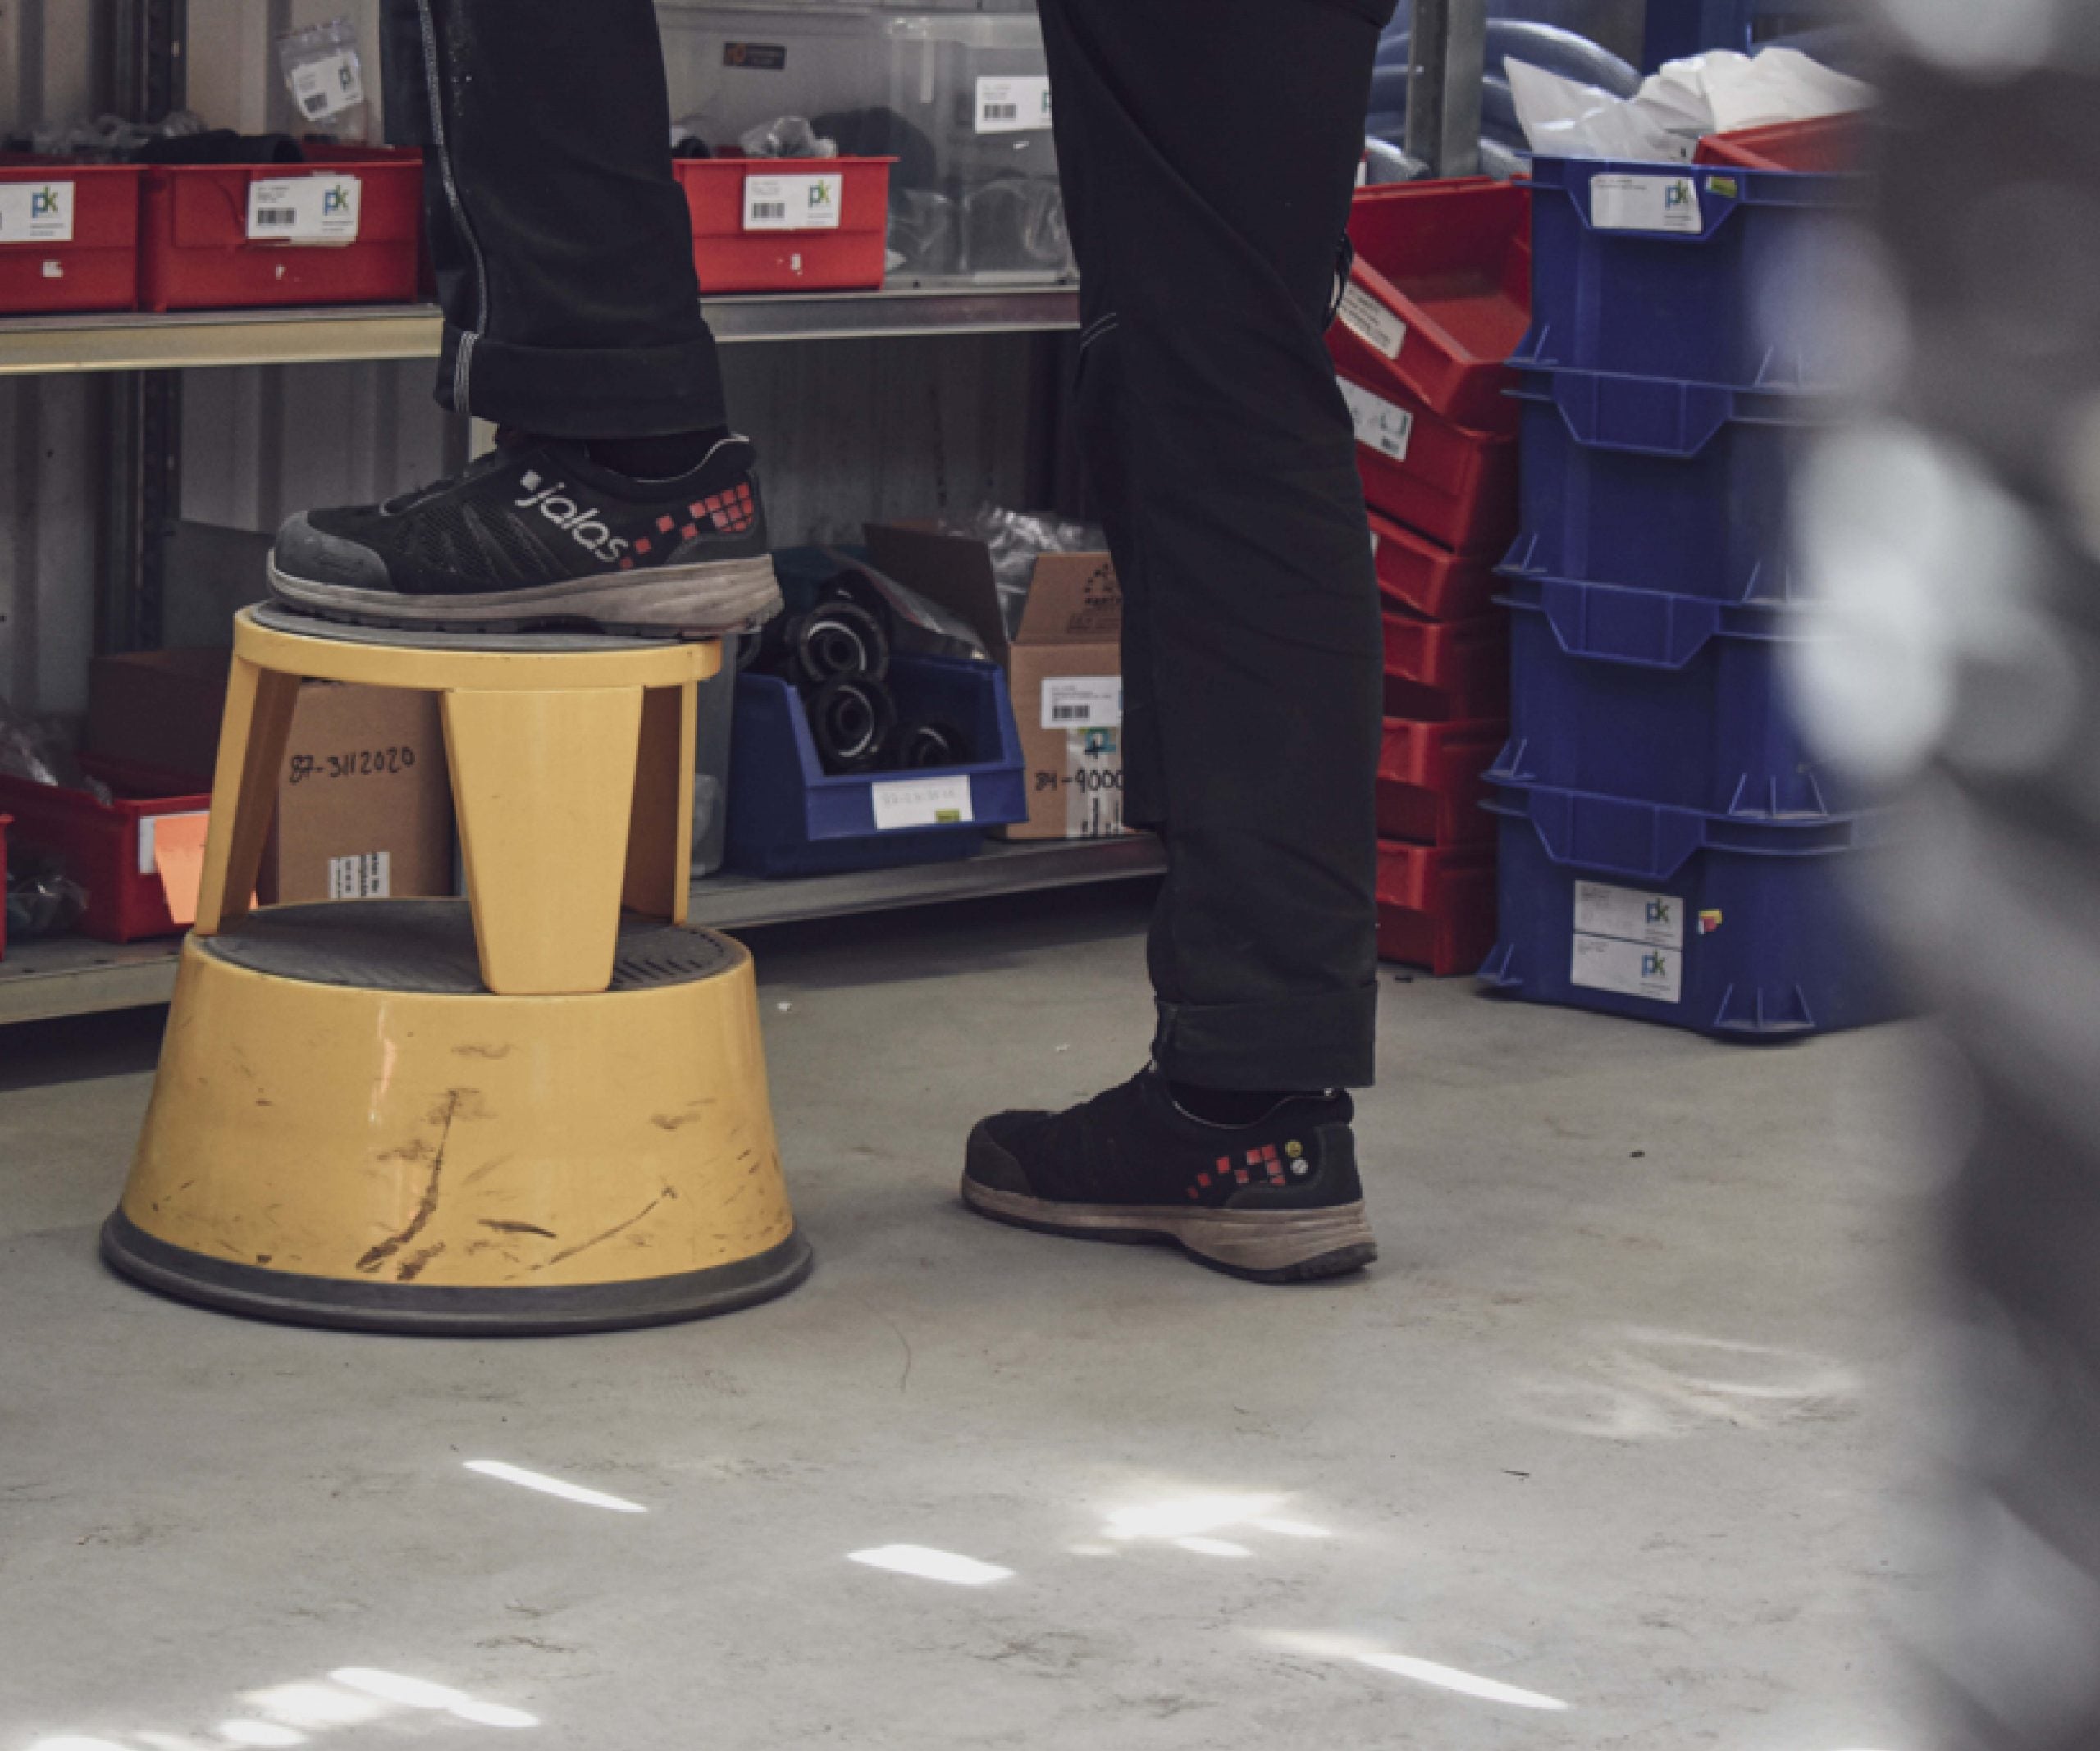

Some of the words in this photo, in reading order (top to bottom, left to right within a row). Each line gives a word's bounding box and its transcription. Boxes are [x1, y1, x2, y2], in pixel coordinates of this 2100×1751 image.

[32, 185, 58, 219] pk
[324, 184, 349, 216] pk
[808, 180, 831, 208] pk
[515, 482, 629, 562] jalas
[1646, 898, 1670, 924] pk
[1642, 950, 1666, 978] pk
